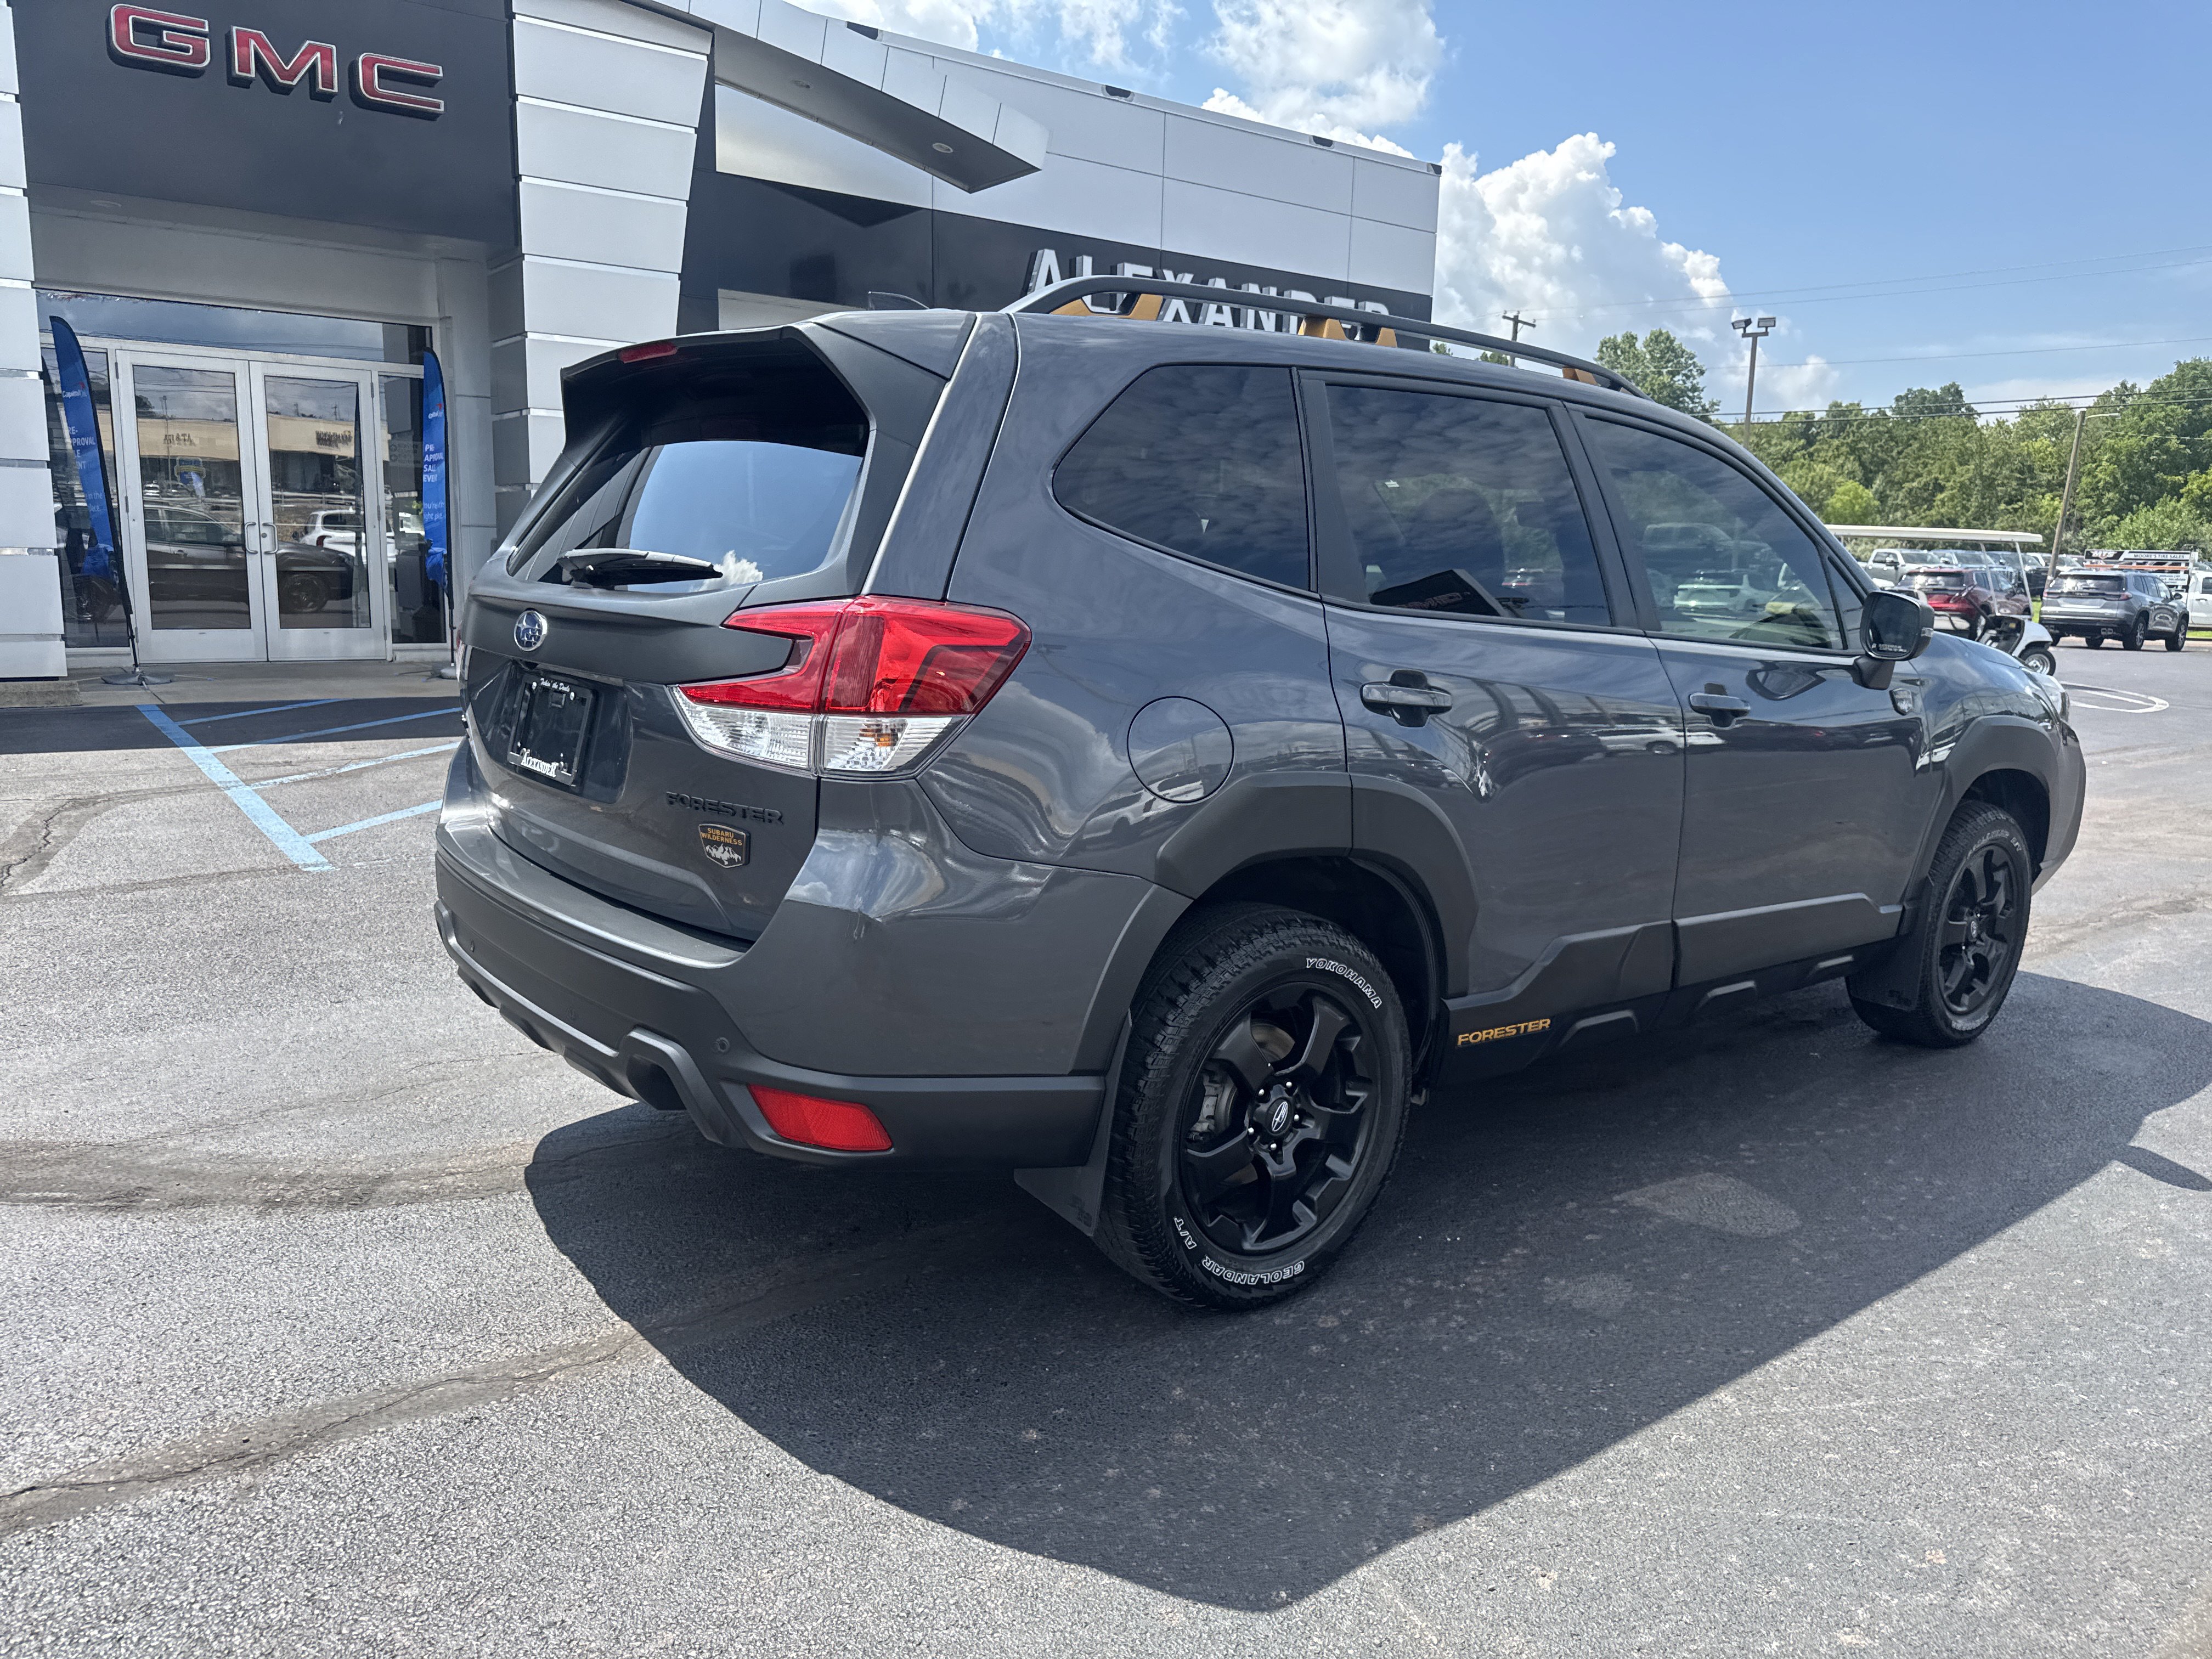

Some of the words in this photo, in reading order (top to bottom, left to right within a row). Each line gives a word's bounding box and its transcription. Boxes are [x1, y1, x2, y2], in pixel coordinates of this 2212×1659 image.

[109, 3, 444, 115] GMC
[1027, 249, 1390, 332] ALXAN
[71, 436, 95, 447] PROVAL
[665, 791, 784, 825] FORESTER
[701, 832, 743, 846] WILDERNESS
[707, 827, 734, 838] SUBARU
[1306, 958, 1383, 1008] YOKOHAMA
[1457, 1018, 1551, 1046] FORESTER
[1174, 1217, 1197, 1249] A/T
[1202, 1256, 1305, 1285] GEOLANDAR
